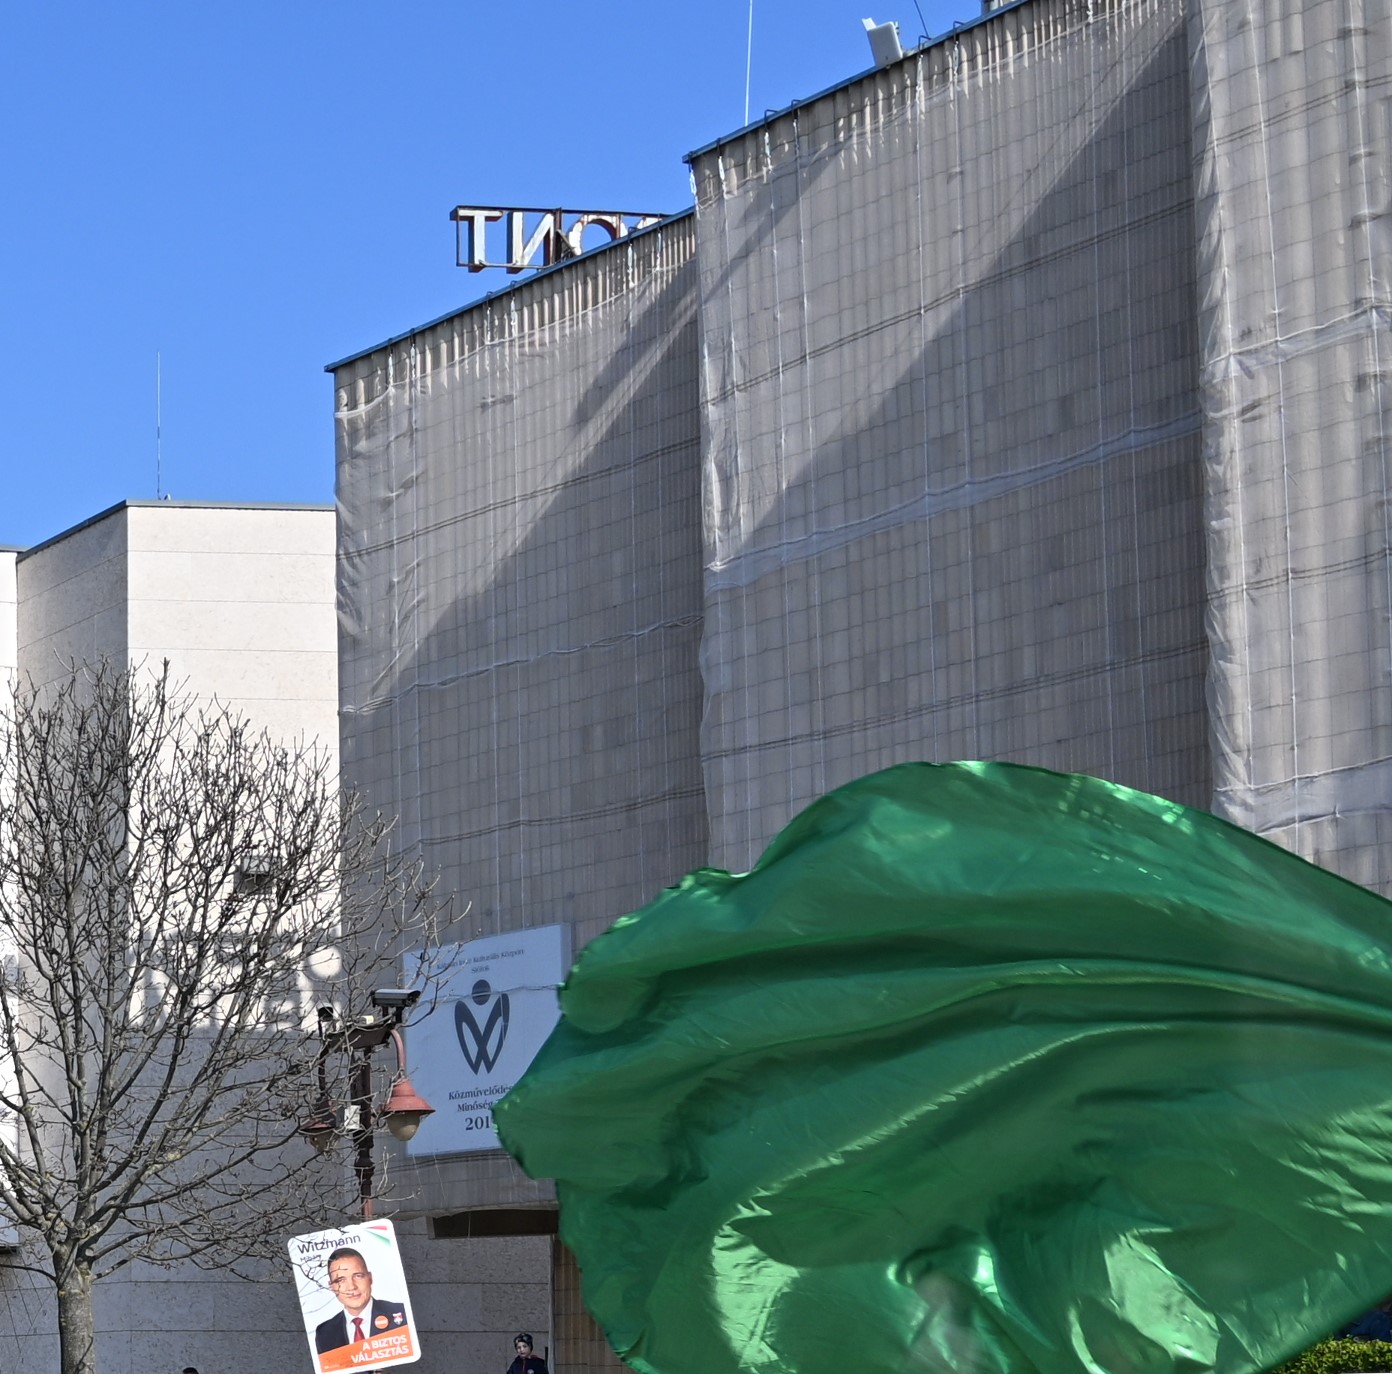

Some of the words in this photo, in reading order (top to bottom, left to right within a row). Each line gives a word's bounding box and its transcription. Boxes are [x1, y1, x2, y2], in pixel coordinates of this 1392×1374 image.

[448, 1084, 513, 1101] Közművelődés
[464, 1115, 490, 1131] 201
[297, 1233, 361, 1254] Witzmann
[362, 1341, 371, 1351] A
[371, 1334, 408, 1350] BIZTOS
[350, 1344, 410, 1363] VÁLASZTÁS
